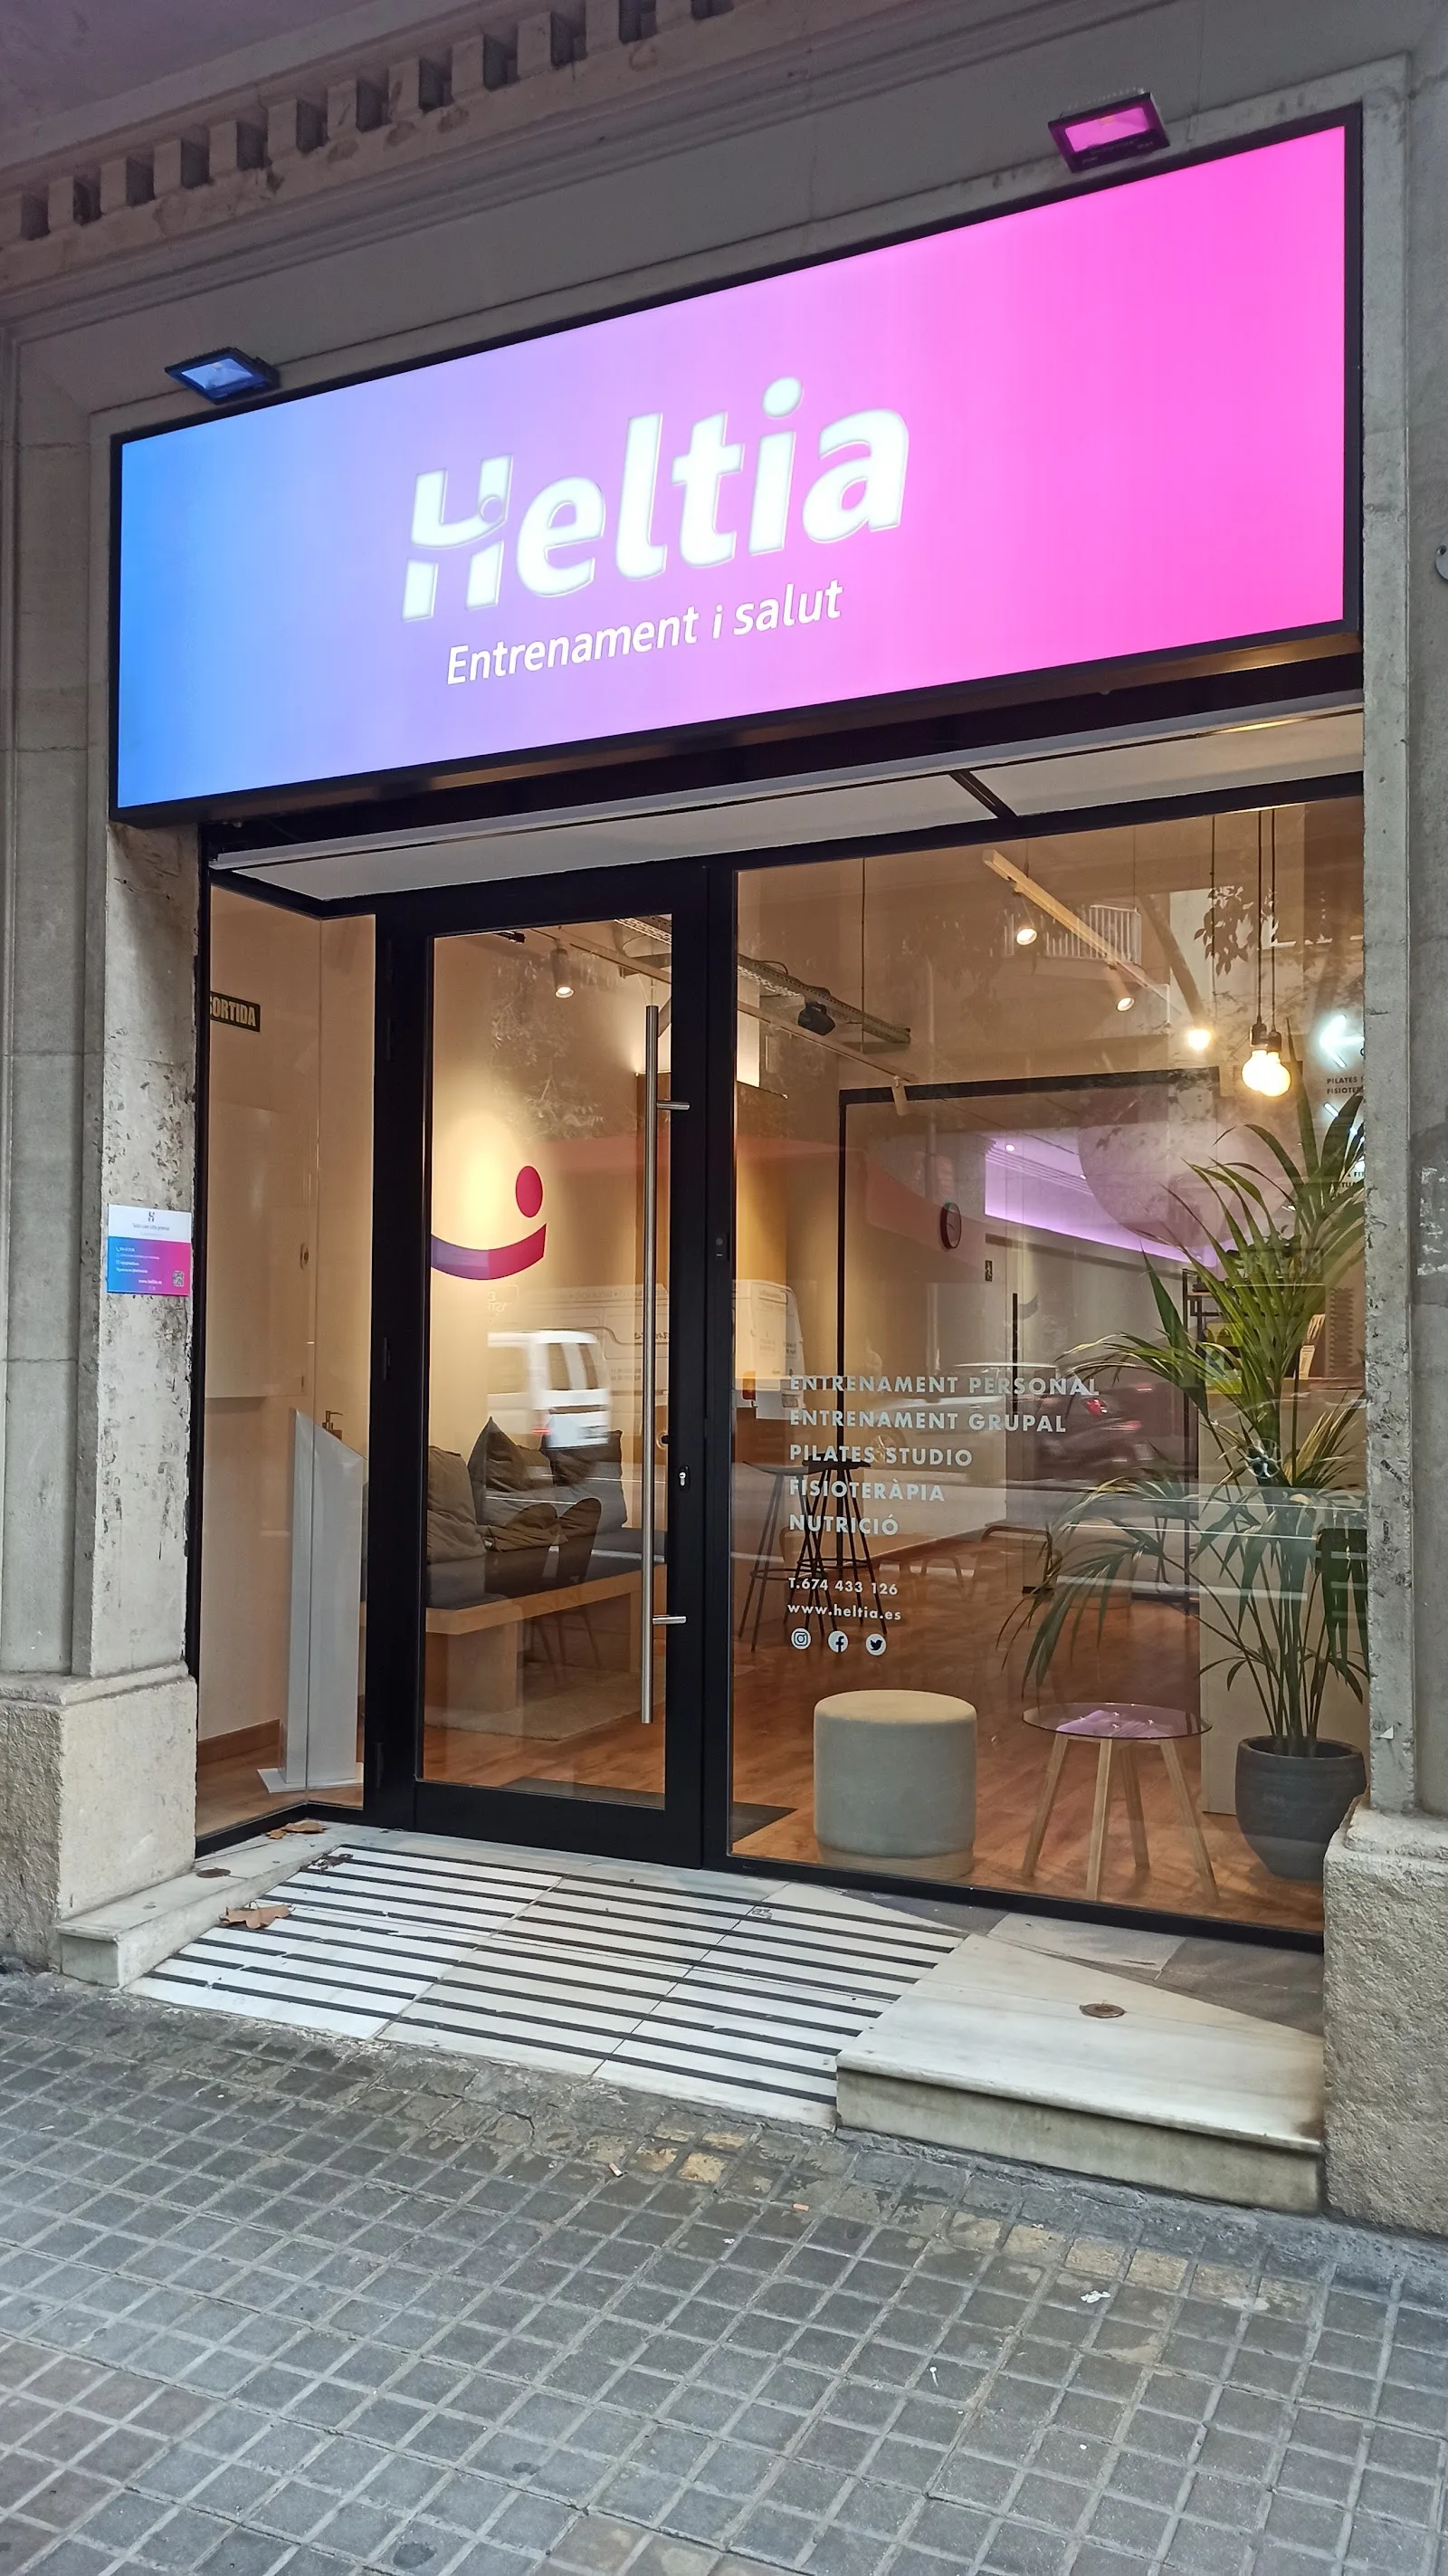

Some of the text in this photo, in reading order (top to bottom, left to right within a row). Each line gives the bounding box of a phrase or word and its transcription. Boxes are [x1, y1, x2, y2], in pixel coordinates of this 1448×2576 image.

[401, 376, 910, 623] Heltia
[446, 578, 844, 686] Entrenament i salut
[210, 996, 256, 1027] ORTIDA
[1327, 1076, 1358, 1084] PILATES
[789, 1374, 1100, 1397] ENTRENAMENT PERSONAL
[789, 1408, 1067, 1433] ENTRENAMENT GRUPAL
[789, 1444, 973, 1466] PILATES STUDIO
[788, 1477, 945, 1502] FISIOTERÀPIA
[788, 1513, 899, 1536] NUTRICIÓ
[787, 1577, 899, 1596] T.674 433 126
[786, 1603, 902, 1621] www.heltia.es
